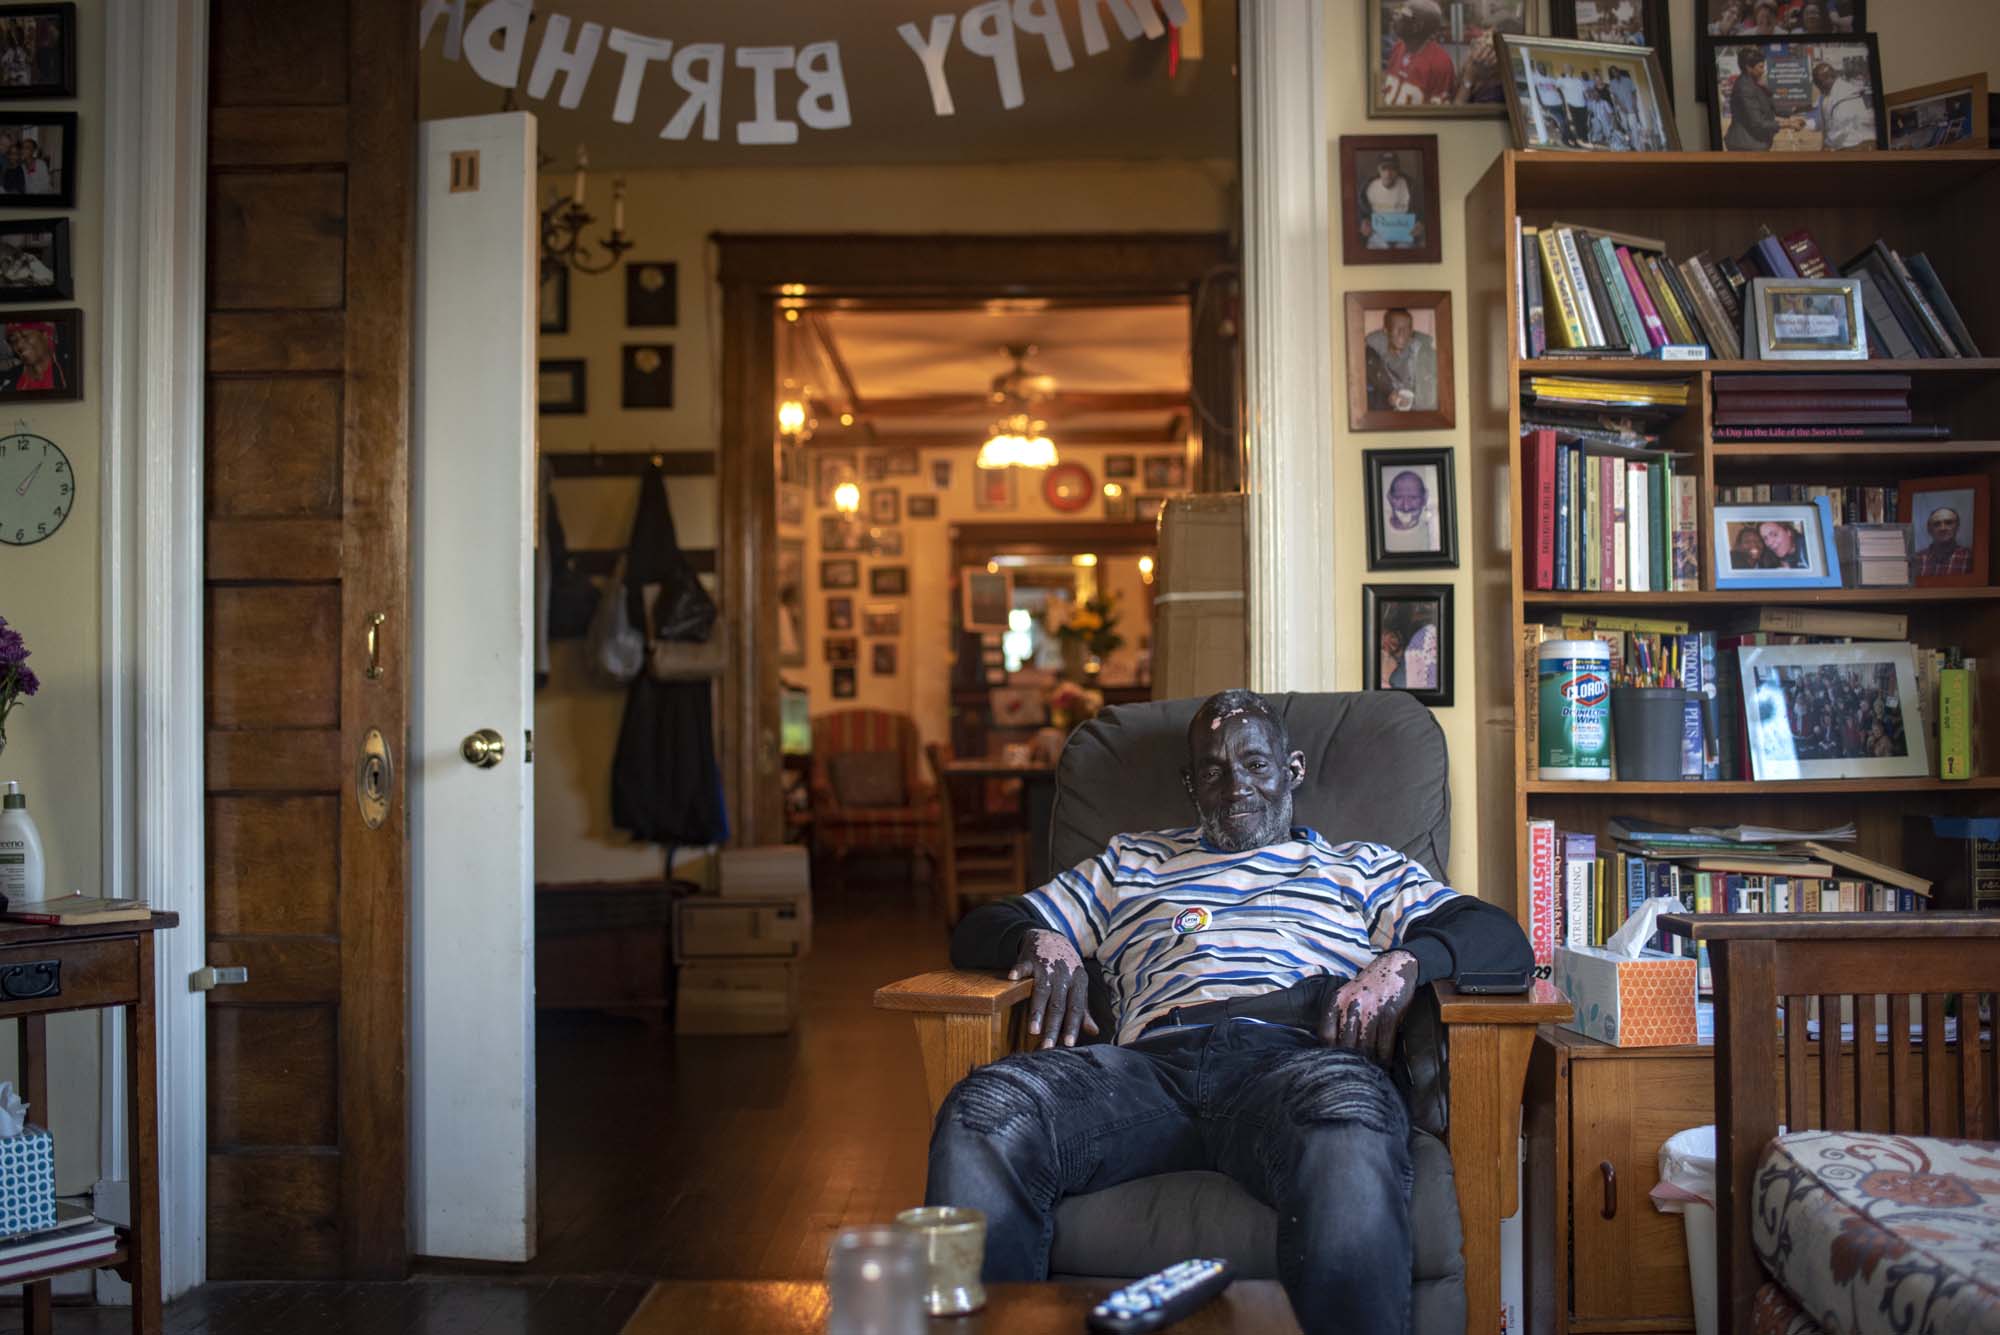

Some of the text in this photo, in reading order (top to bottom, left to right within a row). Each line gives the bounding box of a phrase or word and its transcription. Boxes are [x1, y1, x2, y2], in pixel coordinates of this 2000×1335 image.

[1725, 428, 1742, 438] Day
[1753, 428, 1767, 437] the
[1769, 428, 1784, 437] Life
[1796, 428, 1809, 437] the
[17, 439, 30, 451] 12
[42, 445, 47, 457] 1
[55, 461, 64, 473] 2
[60, 483, 69, 495] 3
[53, 506, 62, 518] 4
[37, 522, 46, 534] 5
[15, 528, 24, 541] 6
[1566, 681, 1607, 701] CLOROX
[1685, 640, 1698, 737] PROCOM PLUS
[1533, 827, 1545, 965] ILLUSTRATORS
[1573, 866, 1582, 944] ATRIC NURSING
